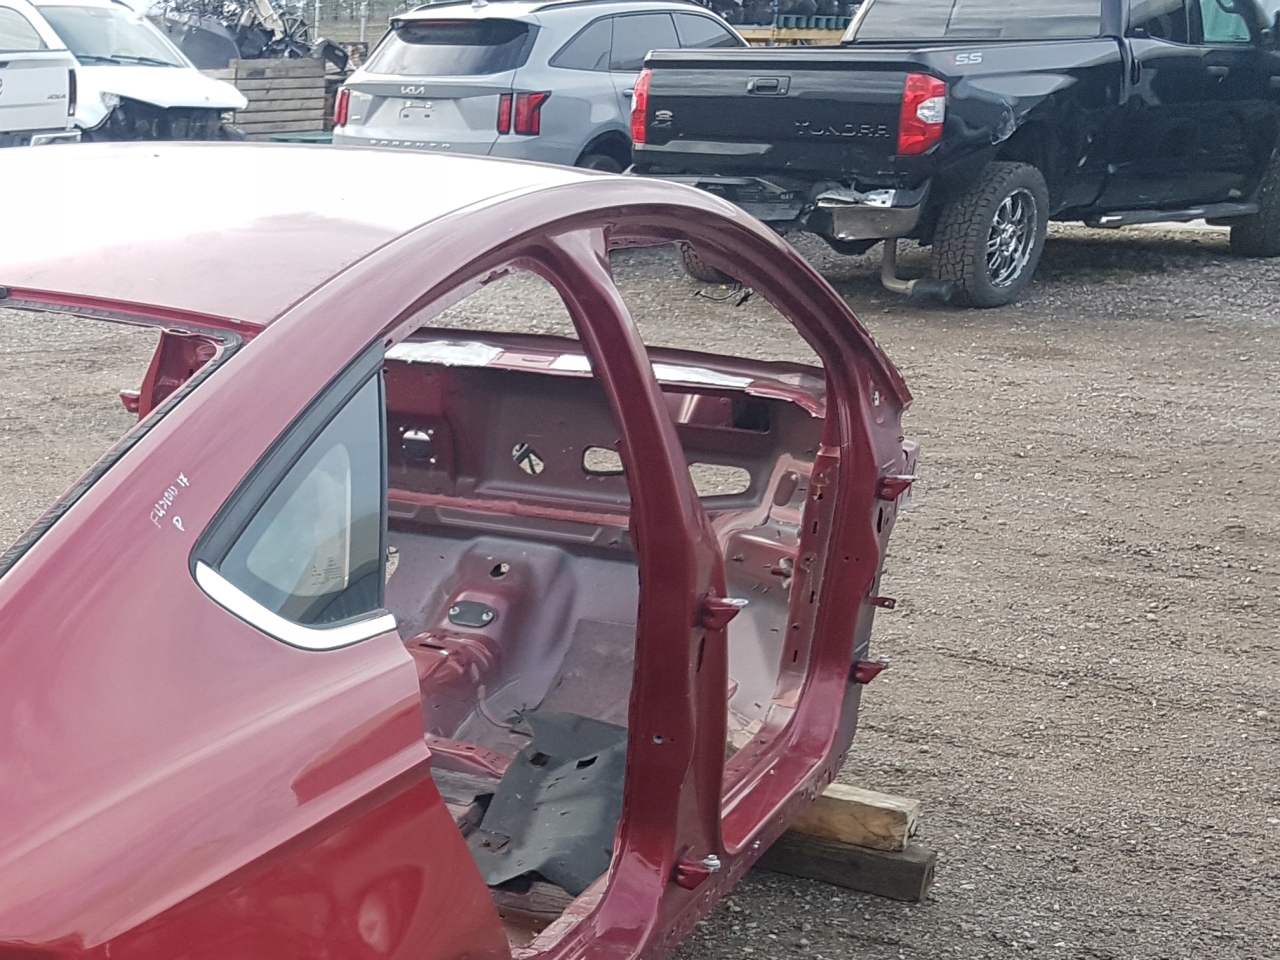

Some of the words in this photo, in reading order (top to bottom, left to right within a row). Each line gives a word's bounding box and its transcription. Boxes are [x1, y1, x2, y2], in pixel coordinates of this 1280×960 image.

[401, 86, 425, 94] KIA
[794, 122, 890, 137] TUNDRA
[172, 515, 186, 532] P
